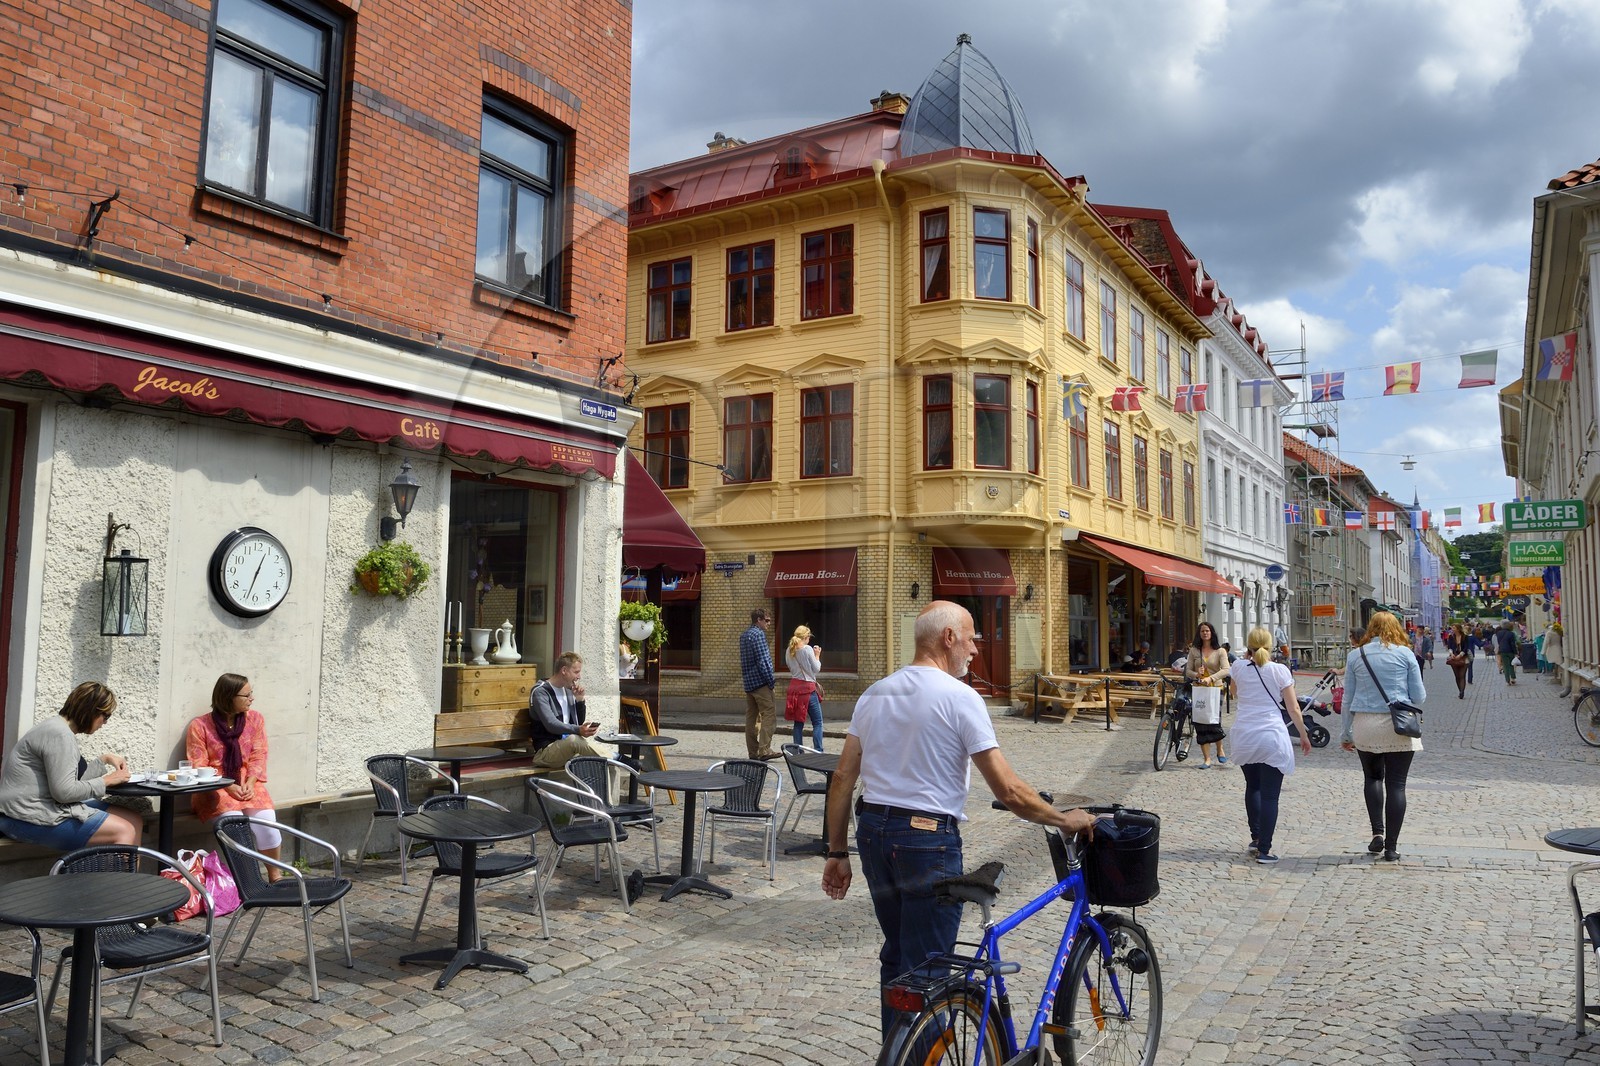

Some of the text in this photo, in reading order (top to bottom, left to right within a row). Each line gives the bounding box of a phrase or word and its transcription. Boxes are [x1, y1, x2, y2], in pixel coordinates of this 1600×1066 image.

[133, 366, 220, 400] Jacob's
[583, 402, 597, 414] Haga
[553, 446, 591, 456] ESPRESSO
[1511, 504, 1578, 521] LÄDER
[244, 546, 251, 555] 11
[254, 542, 263, 551] 12
[1515, 544, 1558, 555] HAGA
[235, 556, 244, 565] 10
[775, 570, 845, 581] Hemma Hos...
[945, 569, 1010, 579] Hemma Hos...
